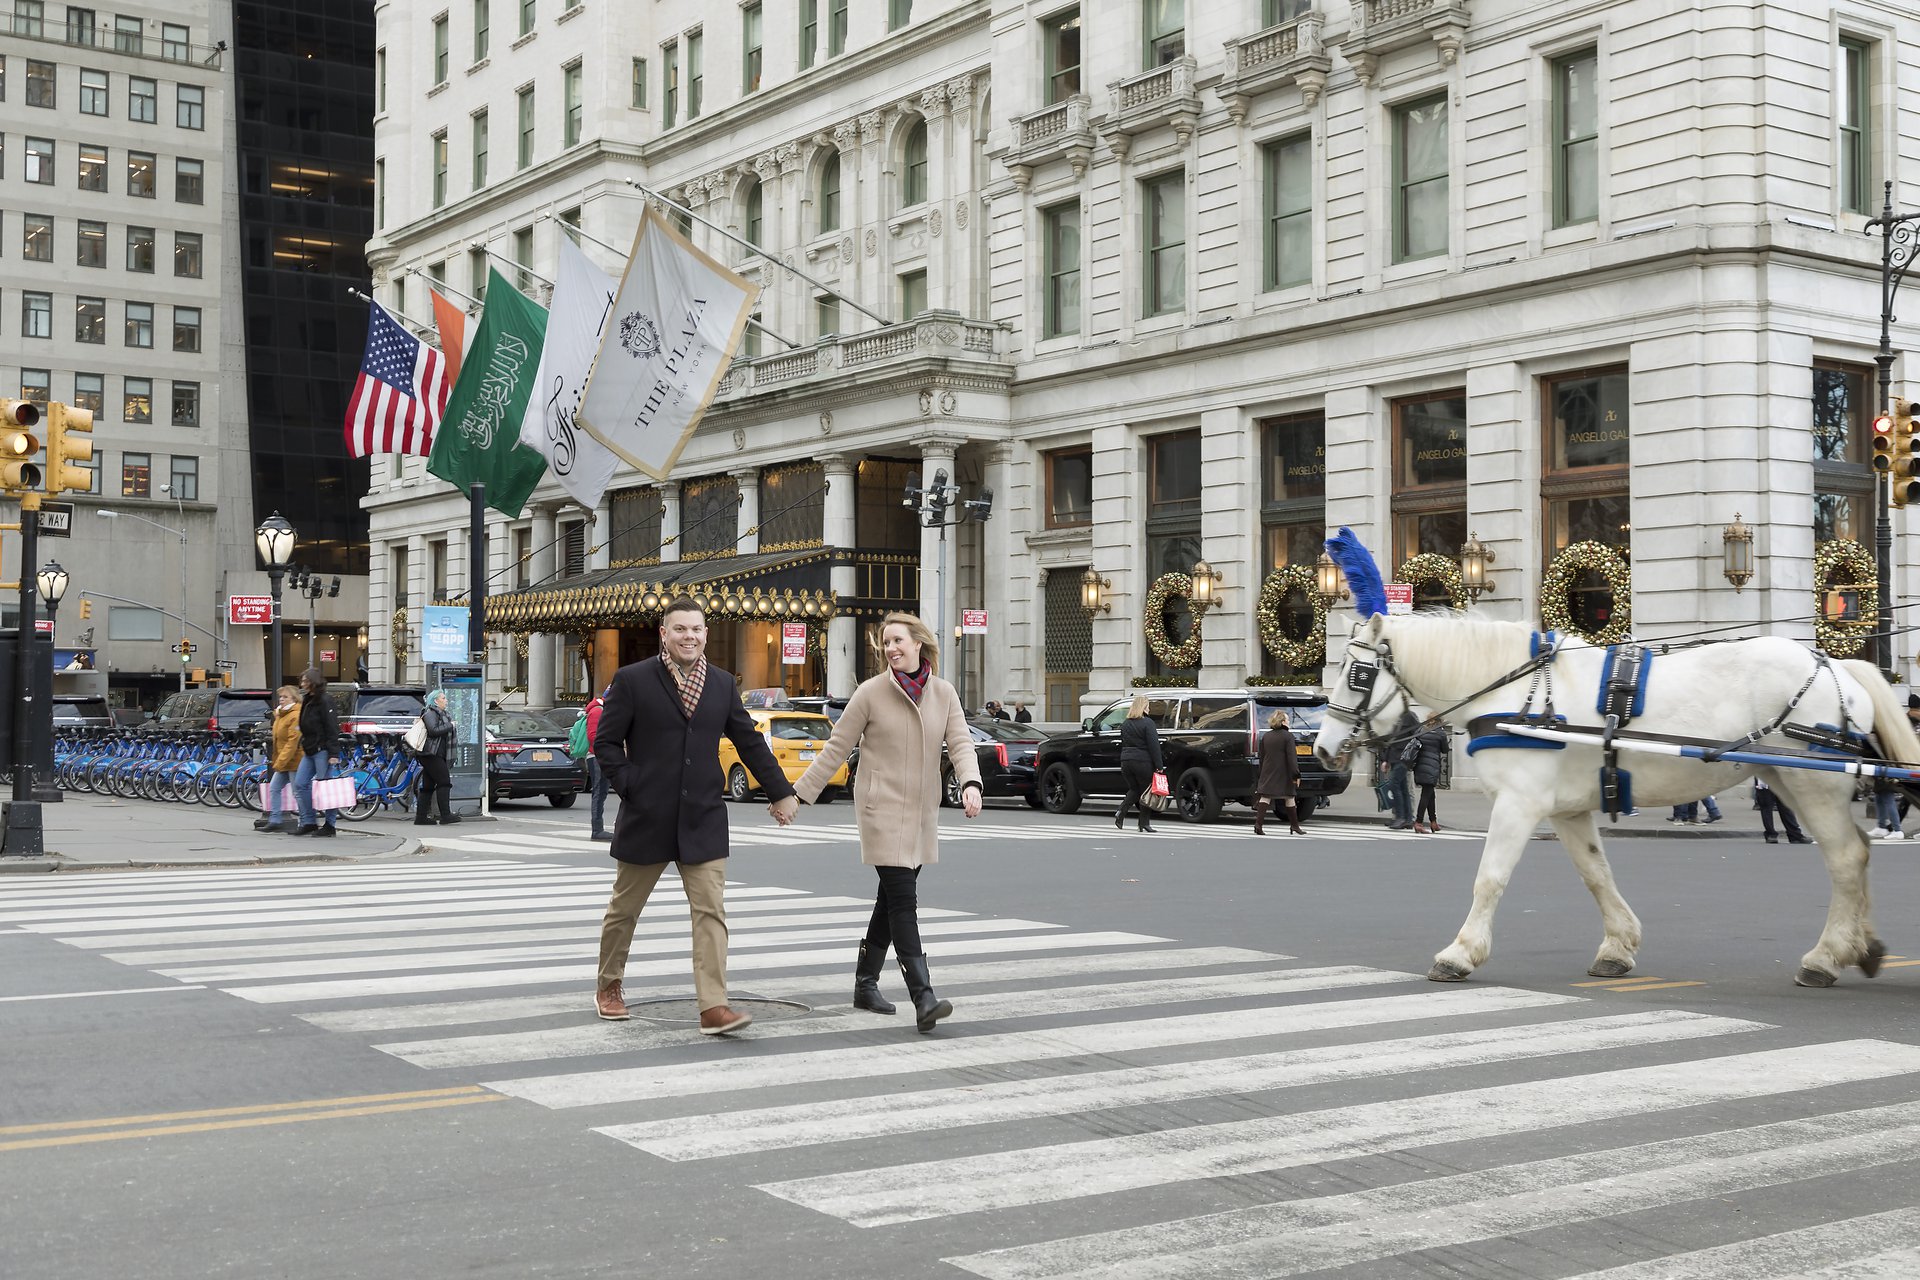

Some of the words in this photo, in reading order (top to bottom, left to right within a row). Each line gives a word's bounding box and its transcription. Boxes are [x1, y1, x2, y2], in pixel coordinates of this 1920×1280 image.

[634, 379, 670, 430] THE
[664, 298, 707, 376] PLAZA
[673, 382, 689, 407] NEW
[688, 343, 708, 374] YORK
[1569, 431, 1608, 443] ANGELO
[1417, 449, 1450, 460] ANGELO
[1287, 464, 1318, 476] ANGELO
[48, 514, 66, 527] WAY
[442, 633, 465, 645] APP
